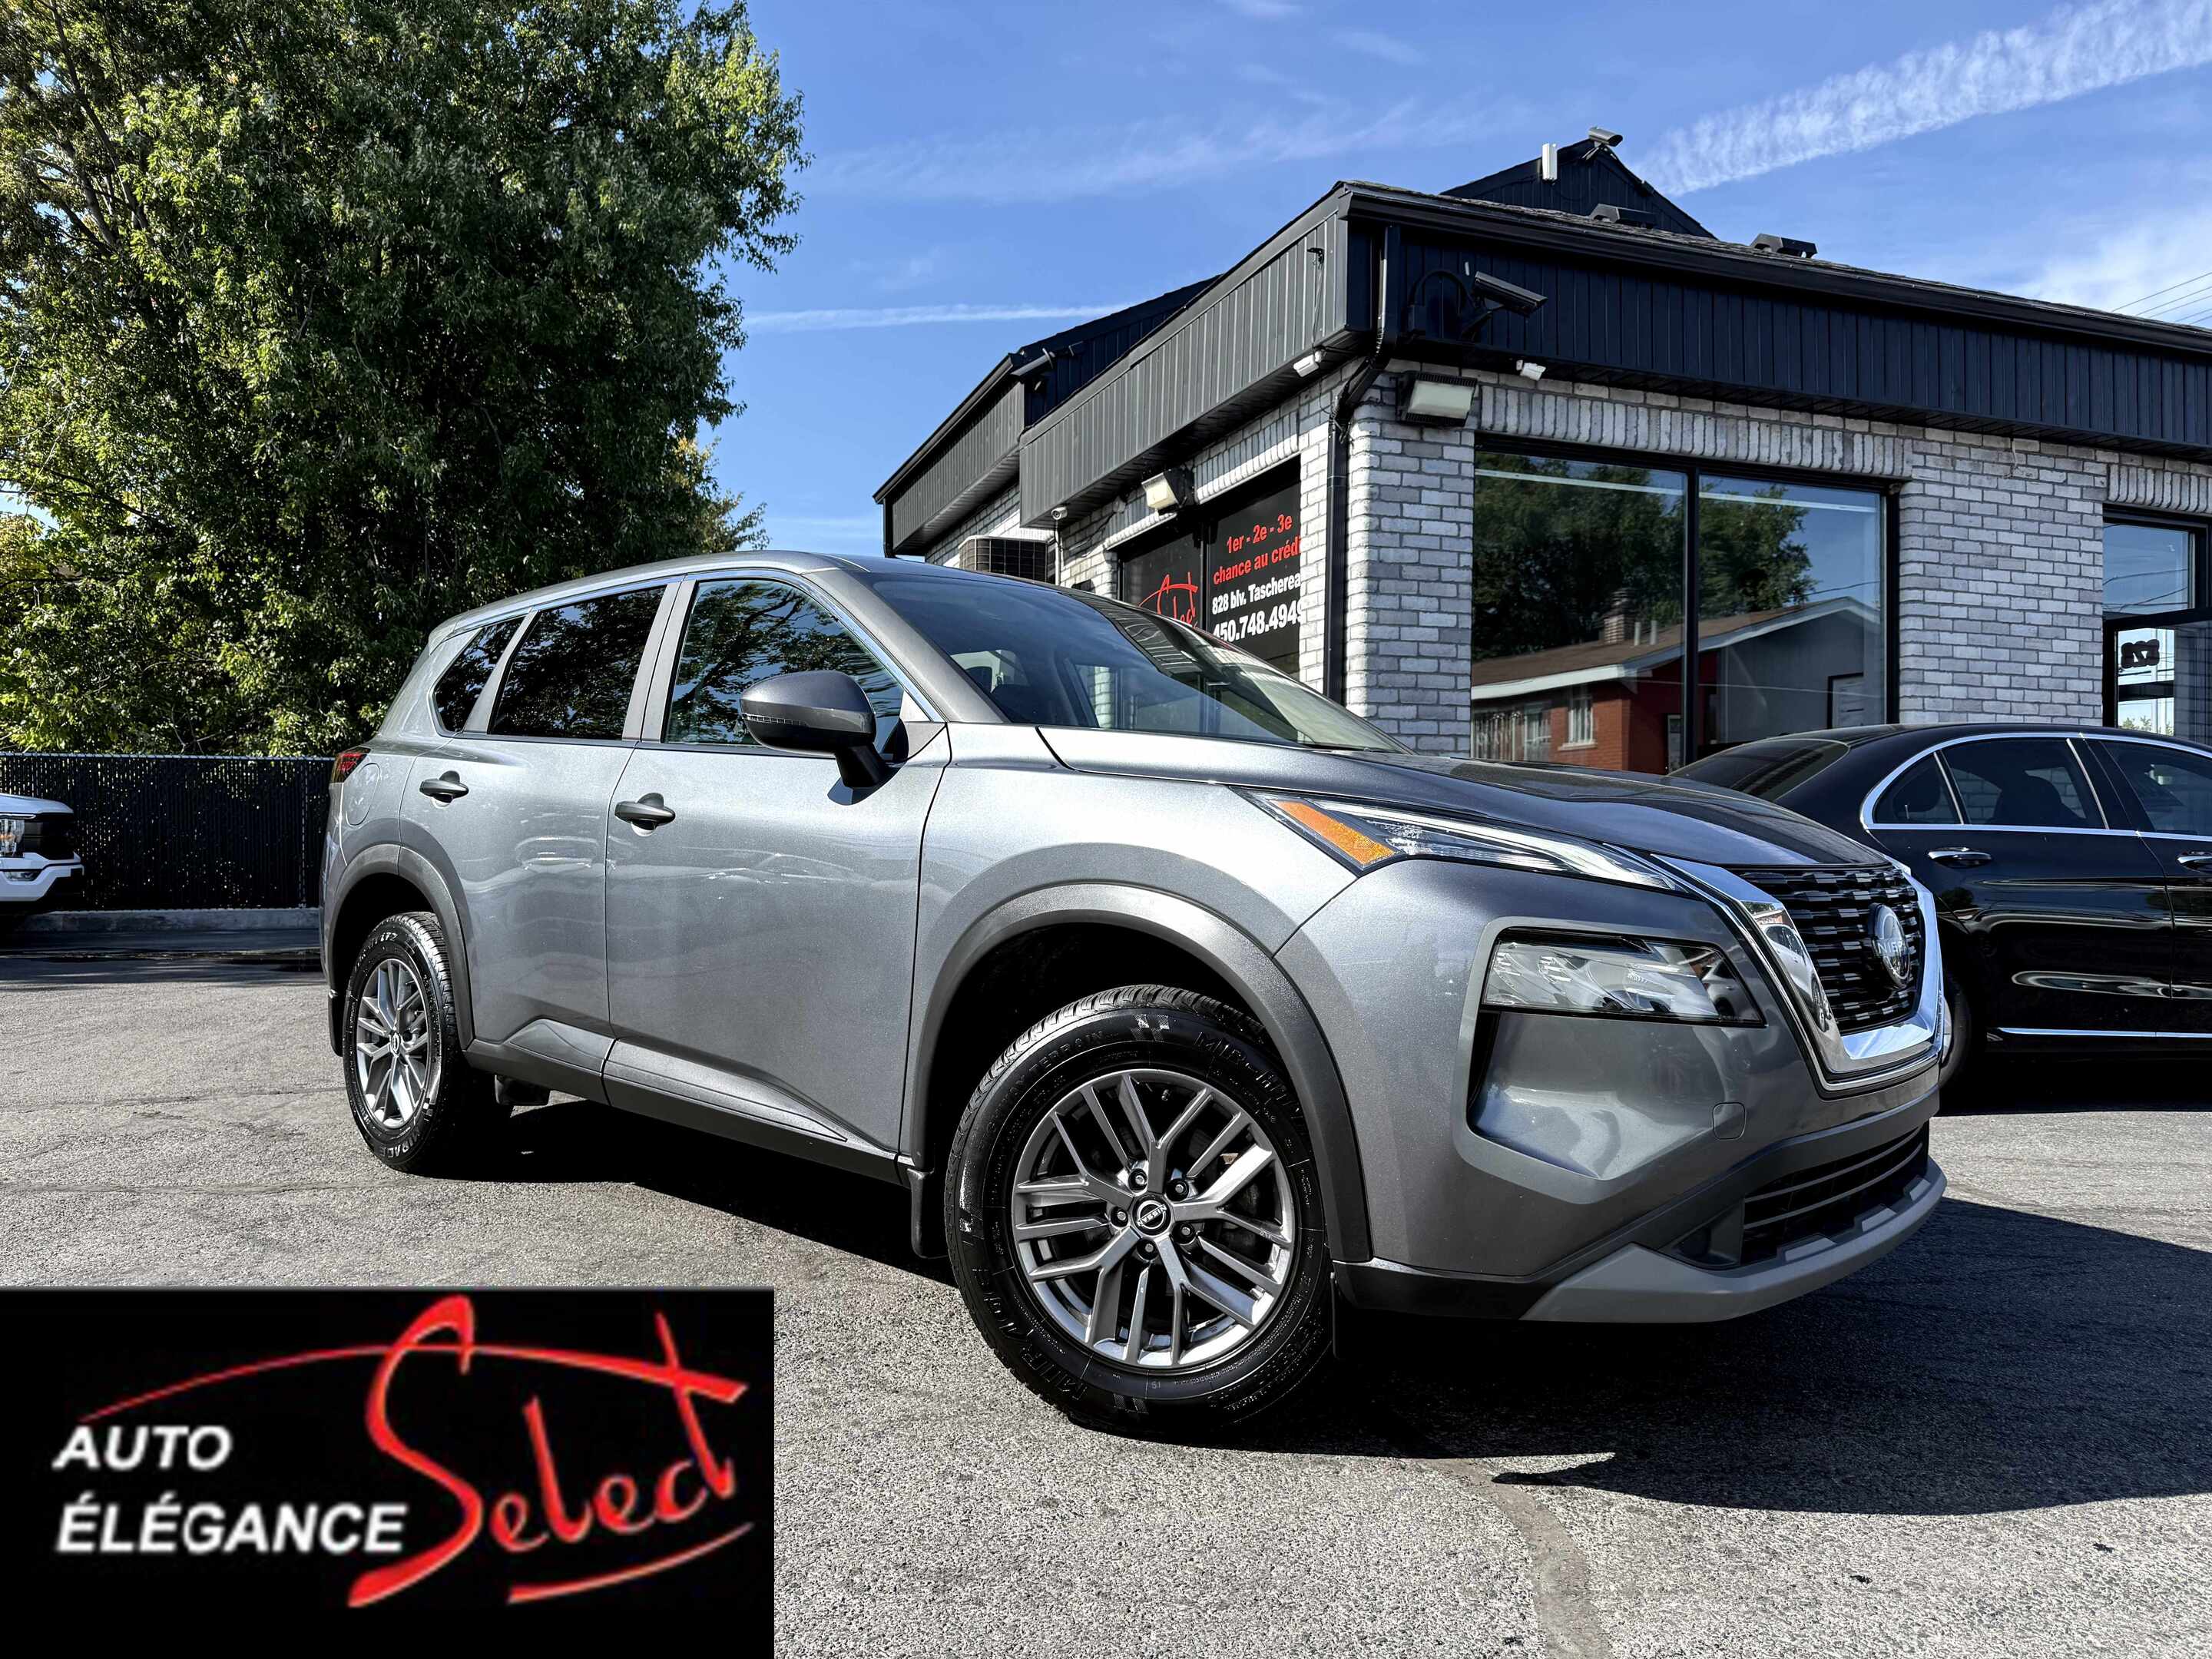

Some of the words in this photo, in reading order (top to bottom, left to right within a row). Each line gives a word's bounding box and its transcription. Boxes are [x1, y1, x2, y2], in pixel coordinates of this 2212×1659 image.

[1227, 536, 1244, 553] 1er
[1253, 525, 1267, 544] 2e
[1277, 514, 1293, 534] 3e
[1213, 566, 1252, 584] chance
[1253, 553, 1269, 570] au
[1212, 593, 1229, 614] 828
[1230, 589, 1247, 609] blv.
[1137, 1204, 1167, 1227] NISSAN
